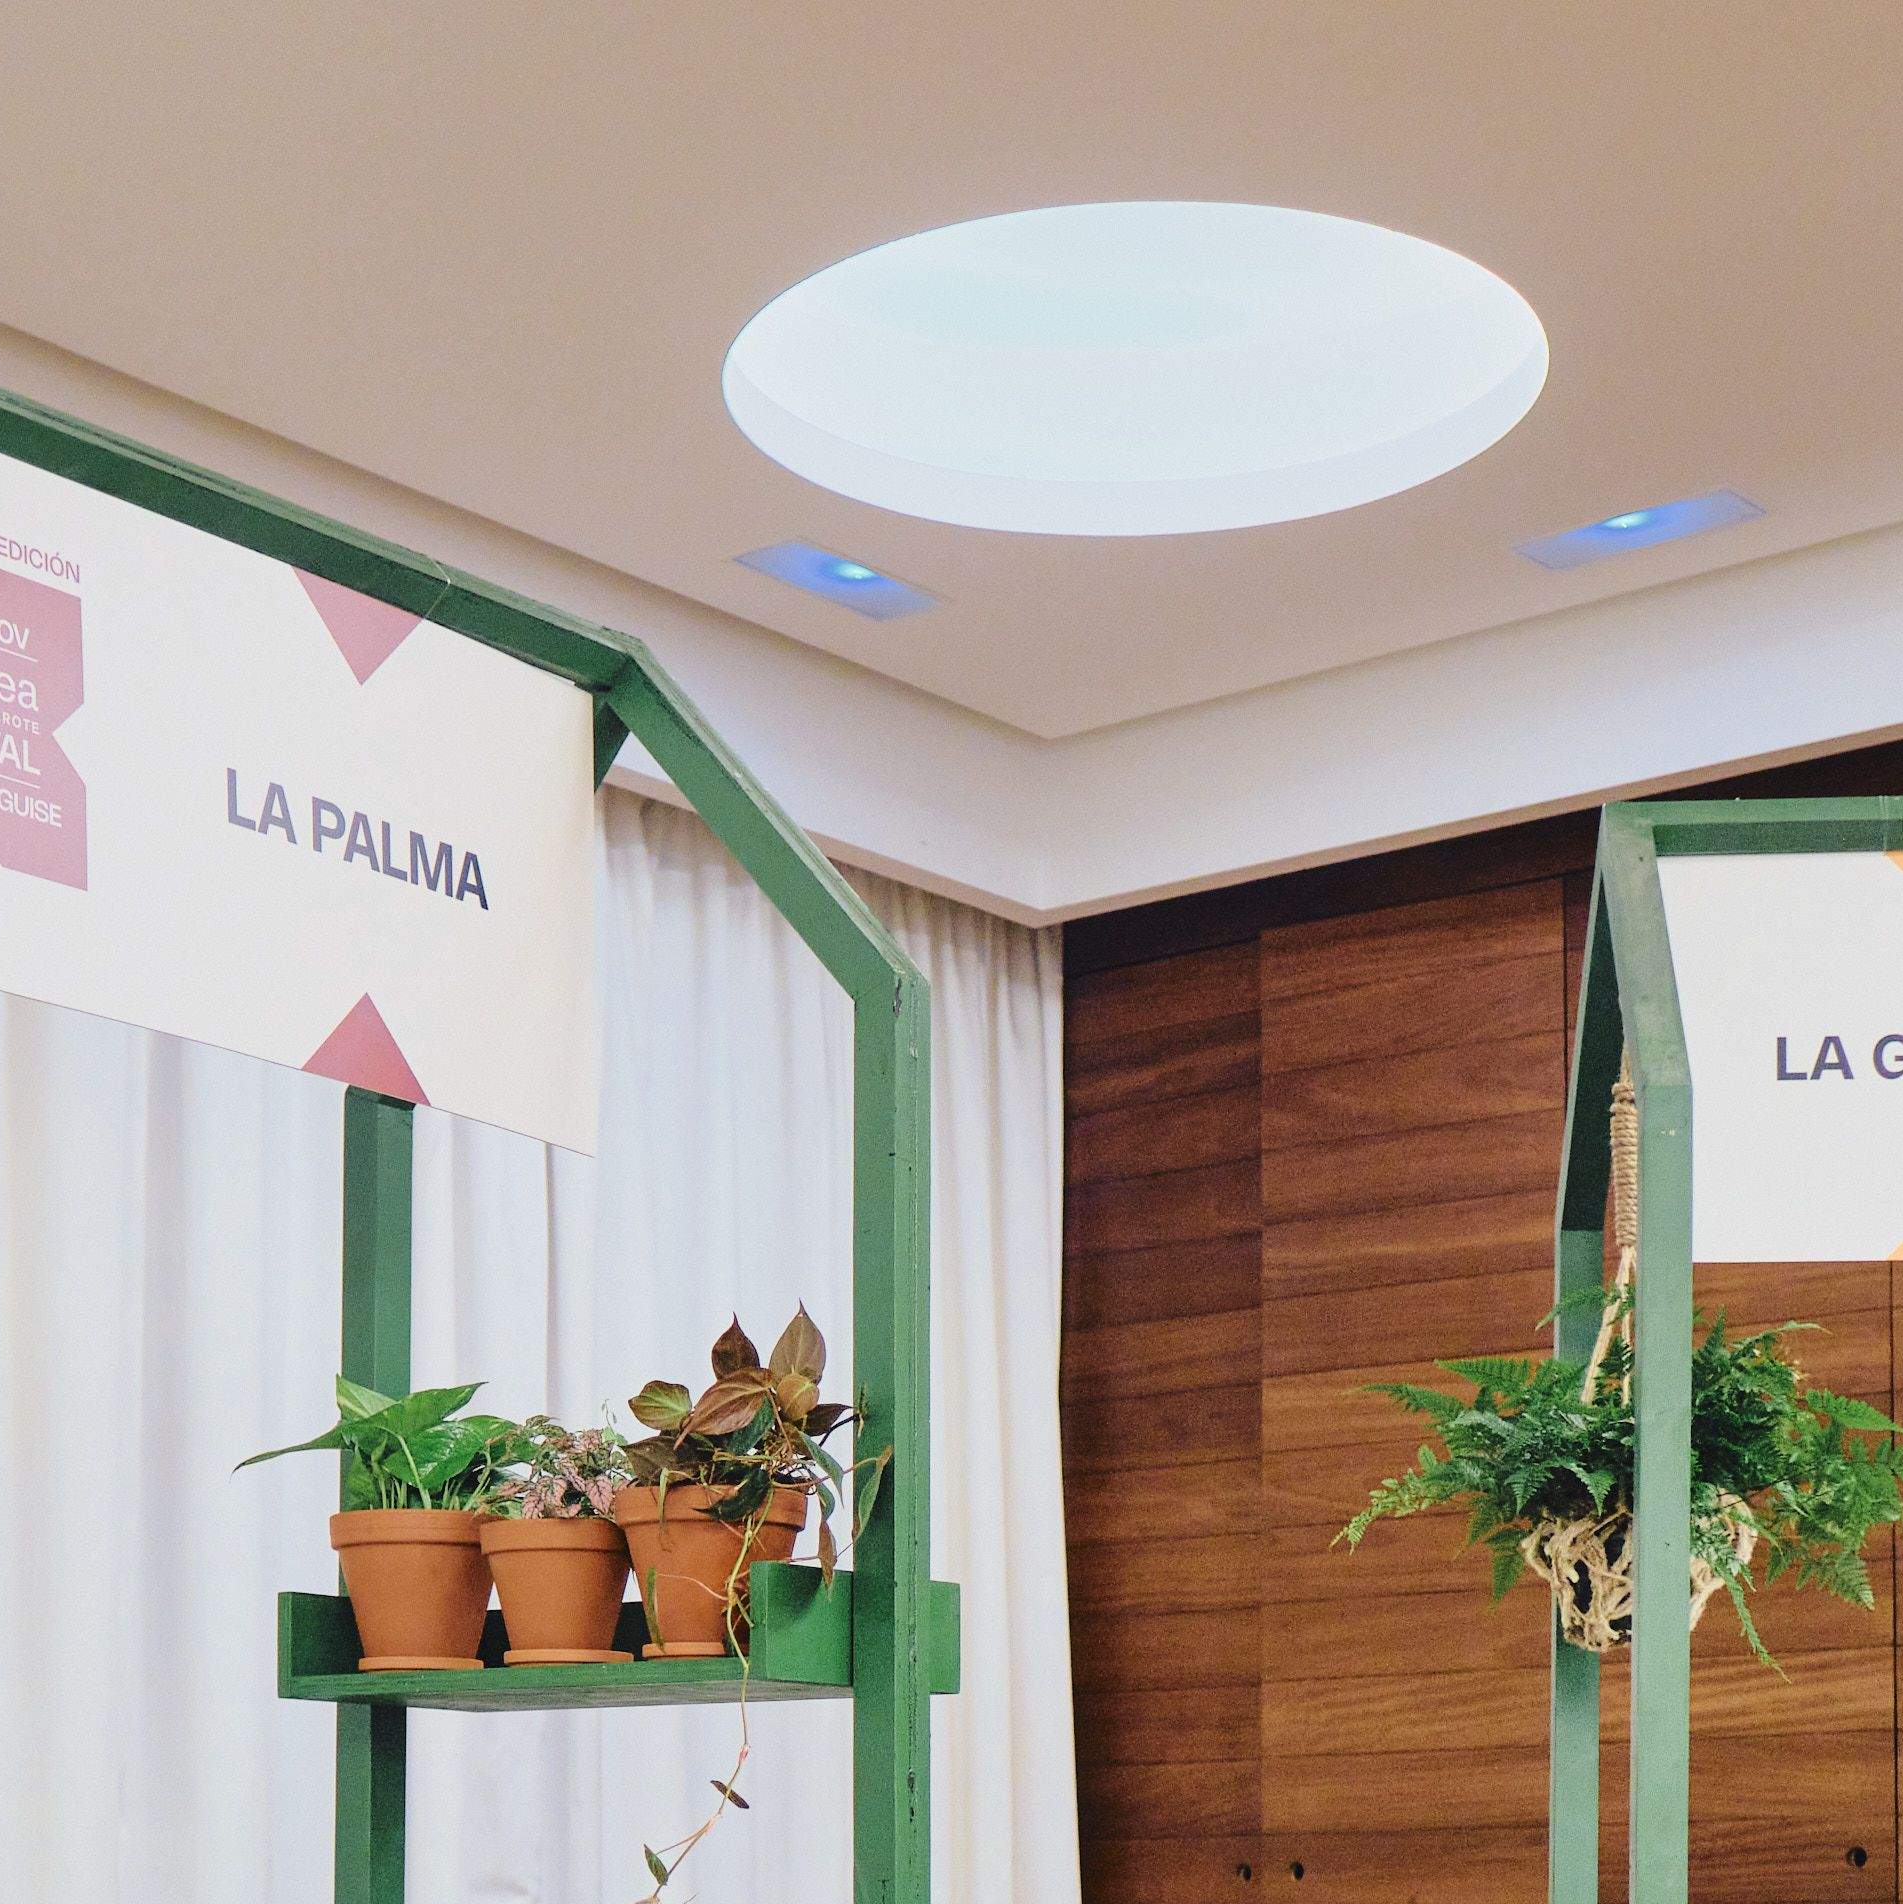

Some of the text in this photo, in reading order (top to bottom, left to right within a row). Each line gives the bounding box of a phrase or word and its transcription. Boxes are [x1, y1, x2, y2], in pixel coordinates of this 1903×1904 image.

[226, 767, 489, 911] LA PALMA
[1776, 1035, 1854, 1081] LA
